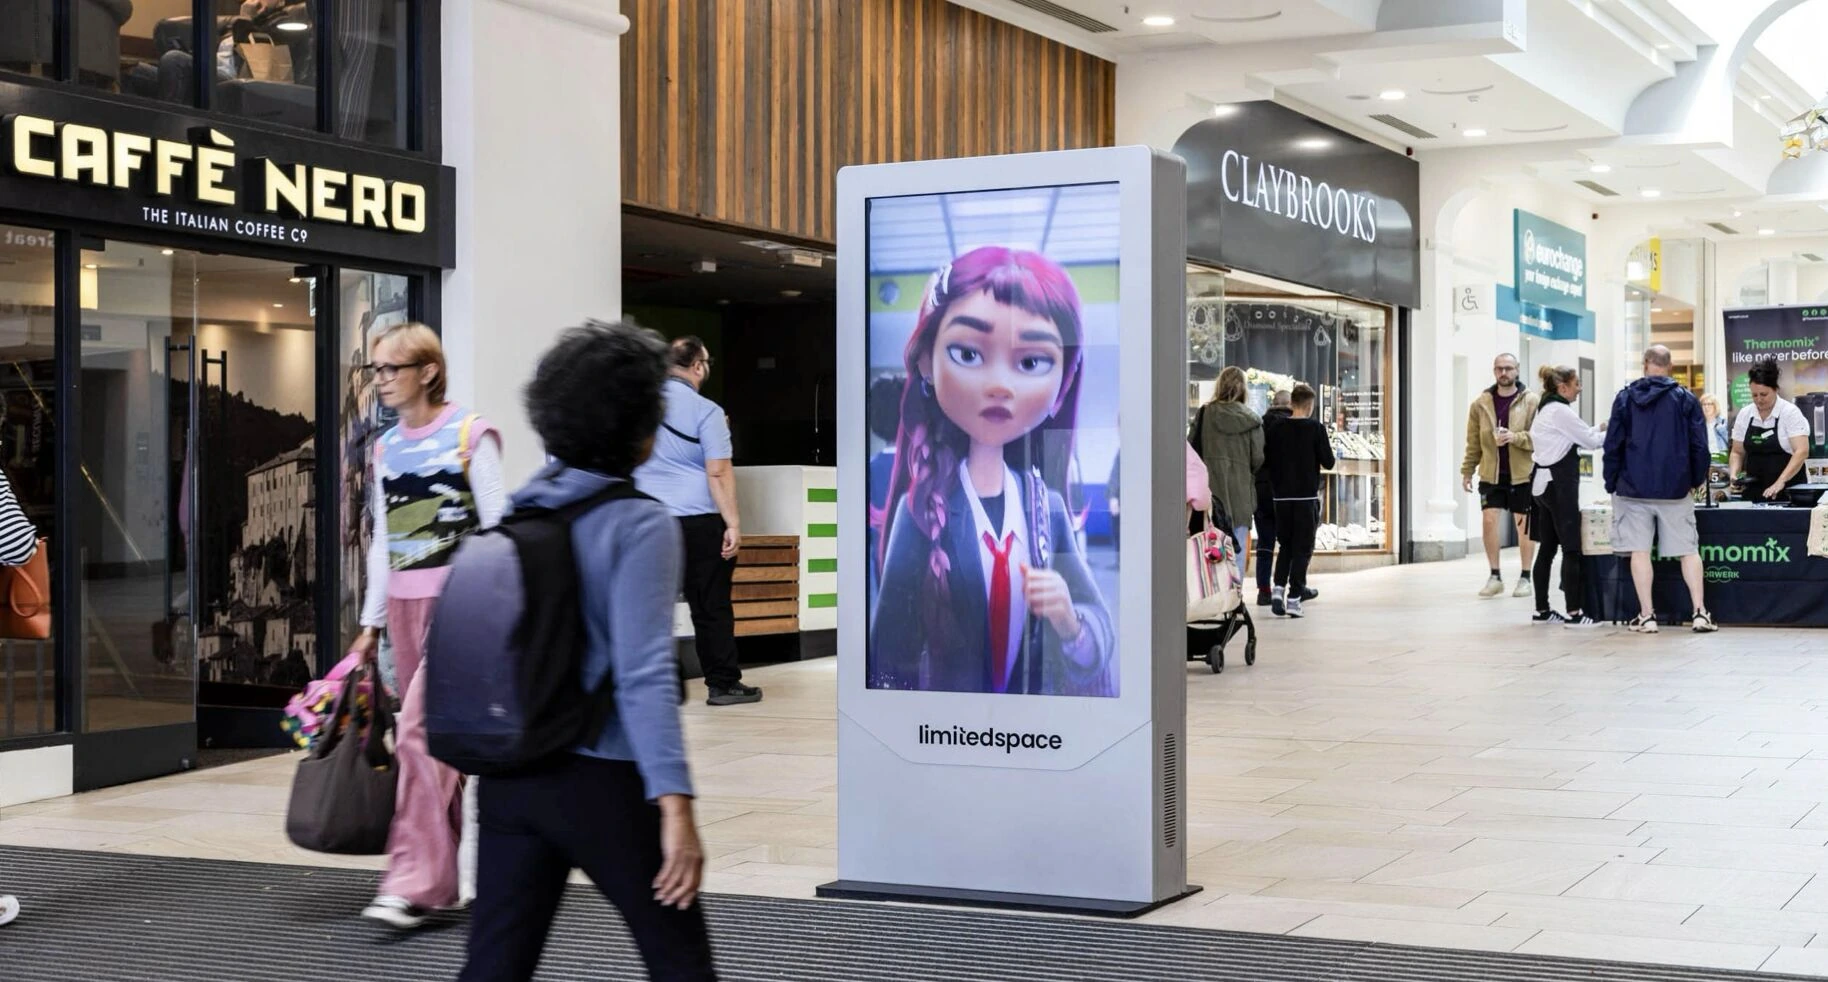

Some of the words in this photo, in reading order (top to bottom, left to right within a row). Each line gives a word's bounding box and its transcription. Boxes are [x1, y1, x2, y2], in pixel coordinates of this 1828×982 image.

[14, 114, 235, 205] CAFFÈ
[265, 157, 426, 234] NERO
[1221, 149, 1376, 244] CLAYBROOKS
[142, 206, 168, 224] THE
[175, 211, 229, 232] ITALIAN
[235, 220, 285, 240] COFFEE
[1536, 244, 1583, 282] eurochange
[1732, 351, 1753, 363] like
[1651, 537, 1791, 562] momix
[1703, 570, 1740, 579] ORWERK
[919, 724, 1063, 754] limitedspace
